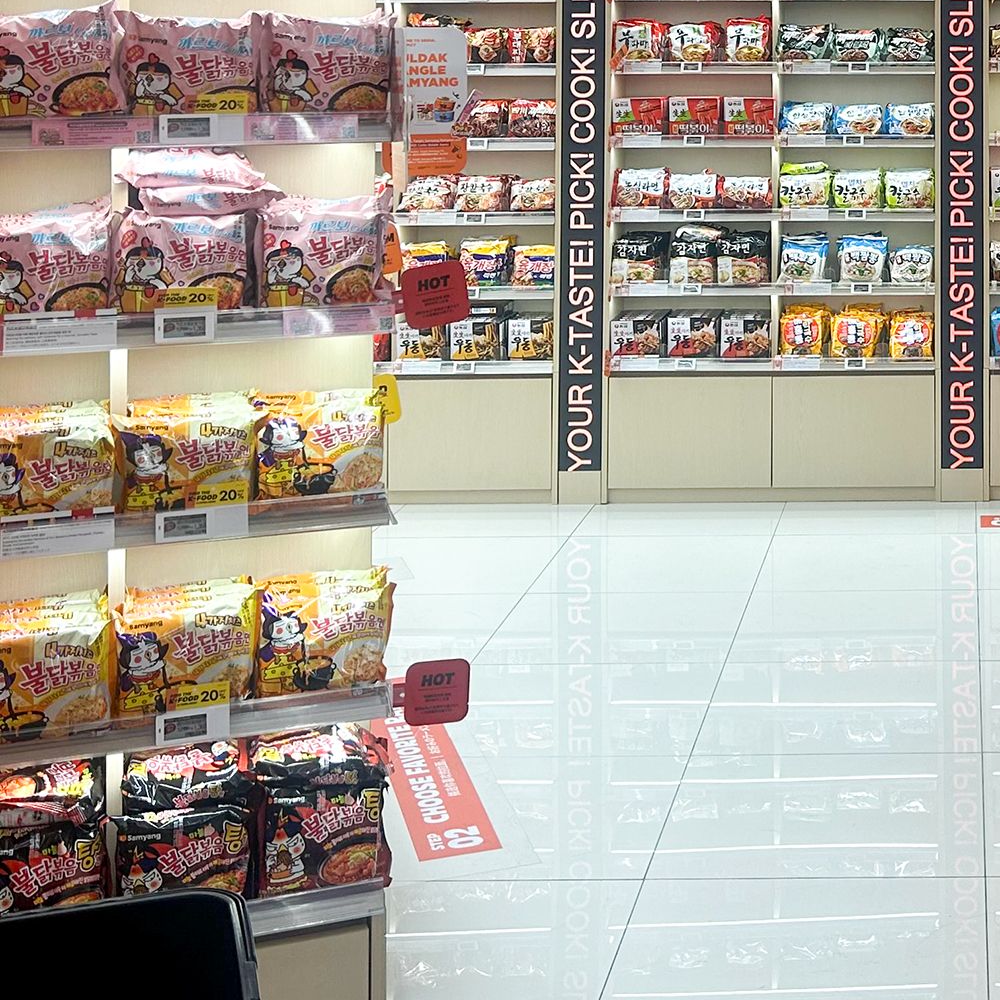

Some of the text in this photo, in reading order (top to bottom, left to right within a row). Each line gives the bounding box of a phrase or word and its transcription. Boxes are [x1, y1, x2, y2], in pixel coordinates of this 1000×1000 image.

[406, 53, 448, 63] LDAK
[570, 48, 596, 143] COOK!
[949, 47, 975, 141] COOK!
[570, 153, 595, 229] PICK!
[949, 151, 975, 226] PICK!
[417, 275, 450, 292] HOT
[568, 240, 594, 374] K-TASTE!
[949, 238, 975, 371] K-TASTE!
[567, 384, 593, 471] YOUR
[949, 381, 975, 469] YOUR
[421, 672, 455, 687] HOT
[387, 725, 430, 776] FAVORITE
[409, 775, 450, 824] CHOOSE
[444, 825, 484, 849] 02
[426, 833, 446, 851] STEP
